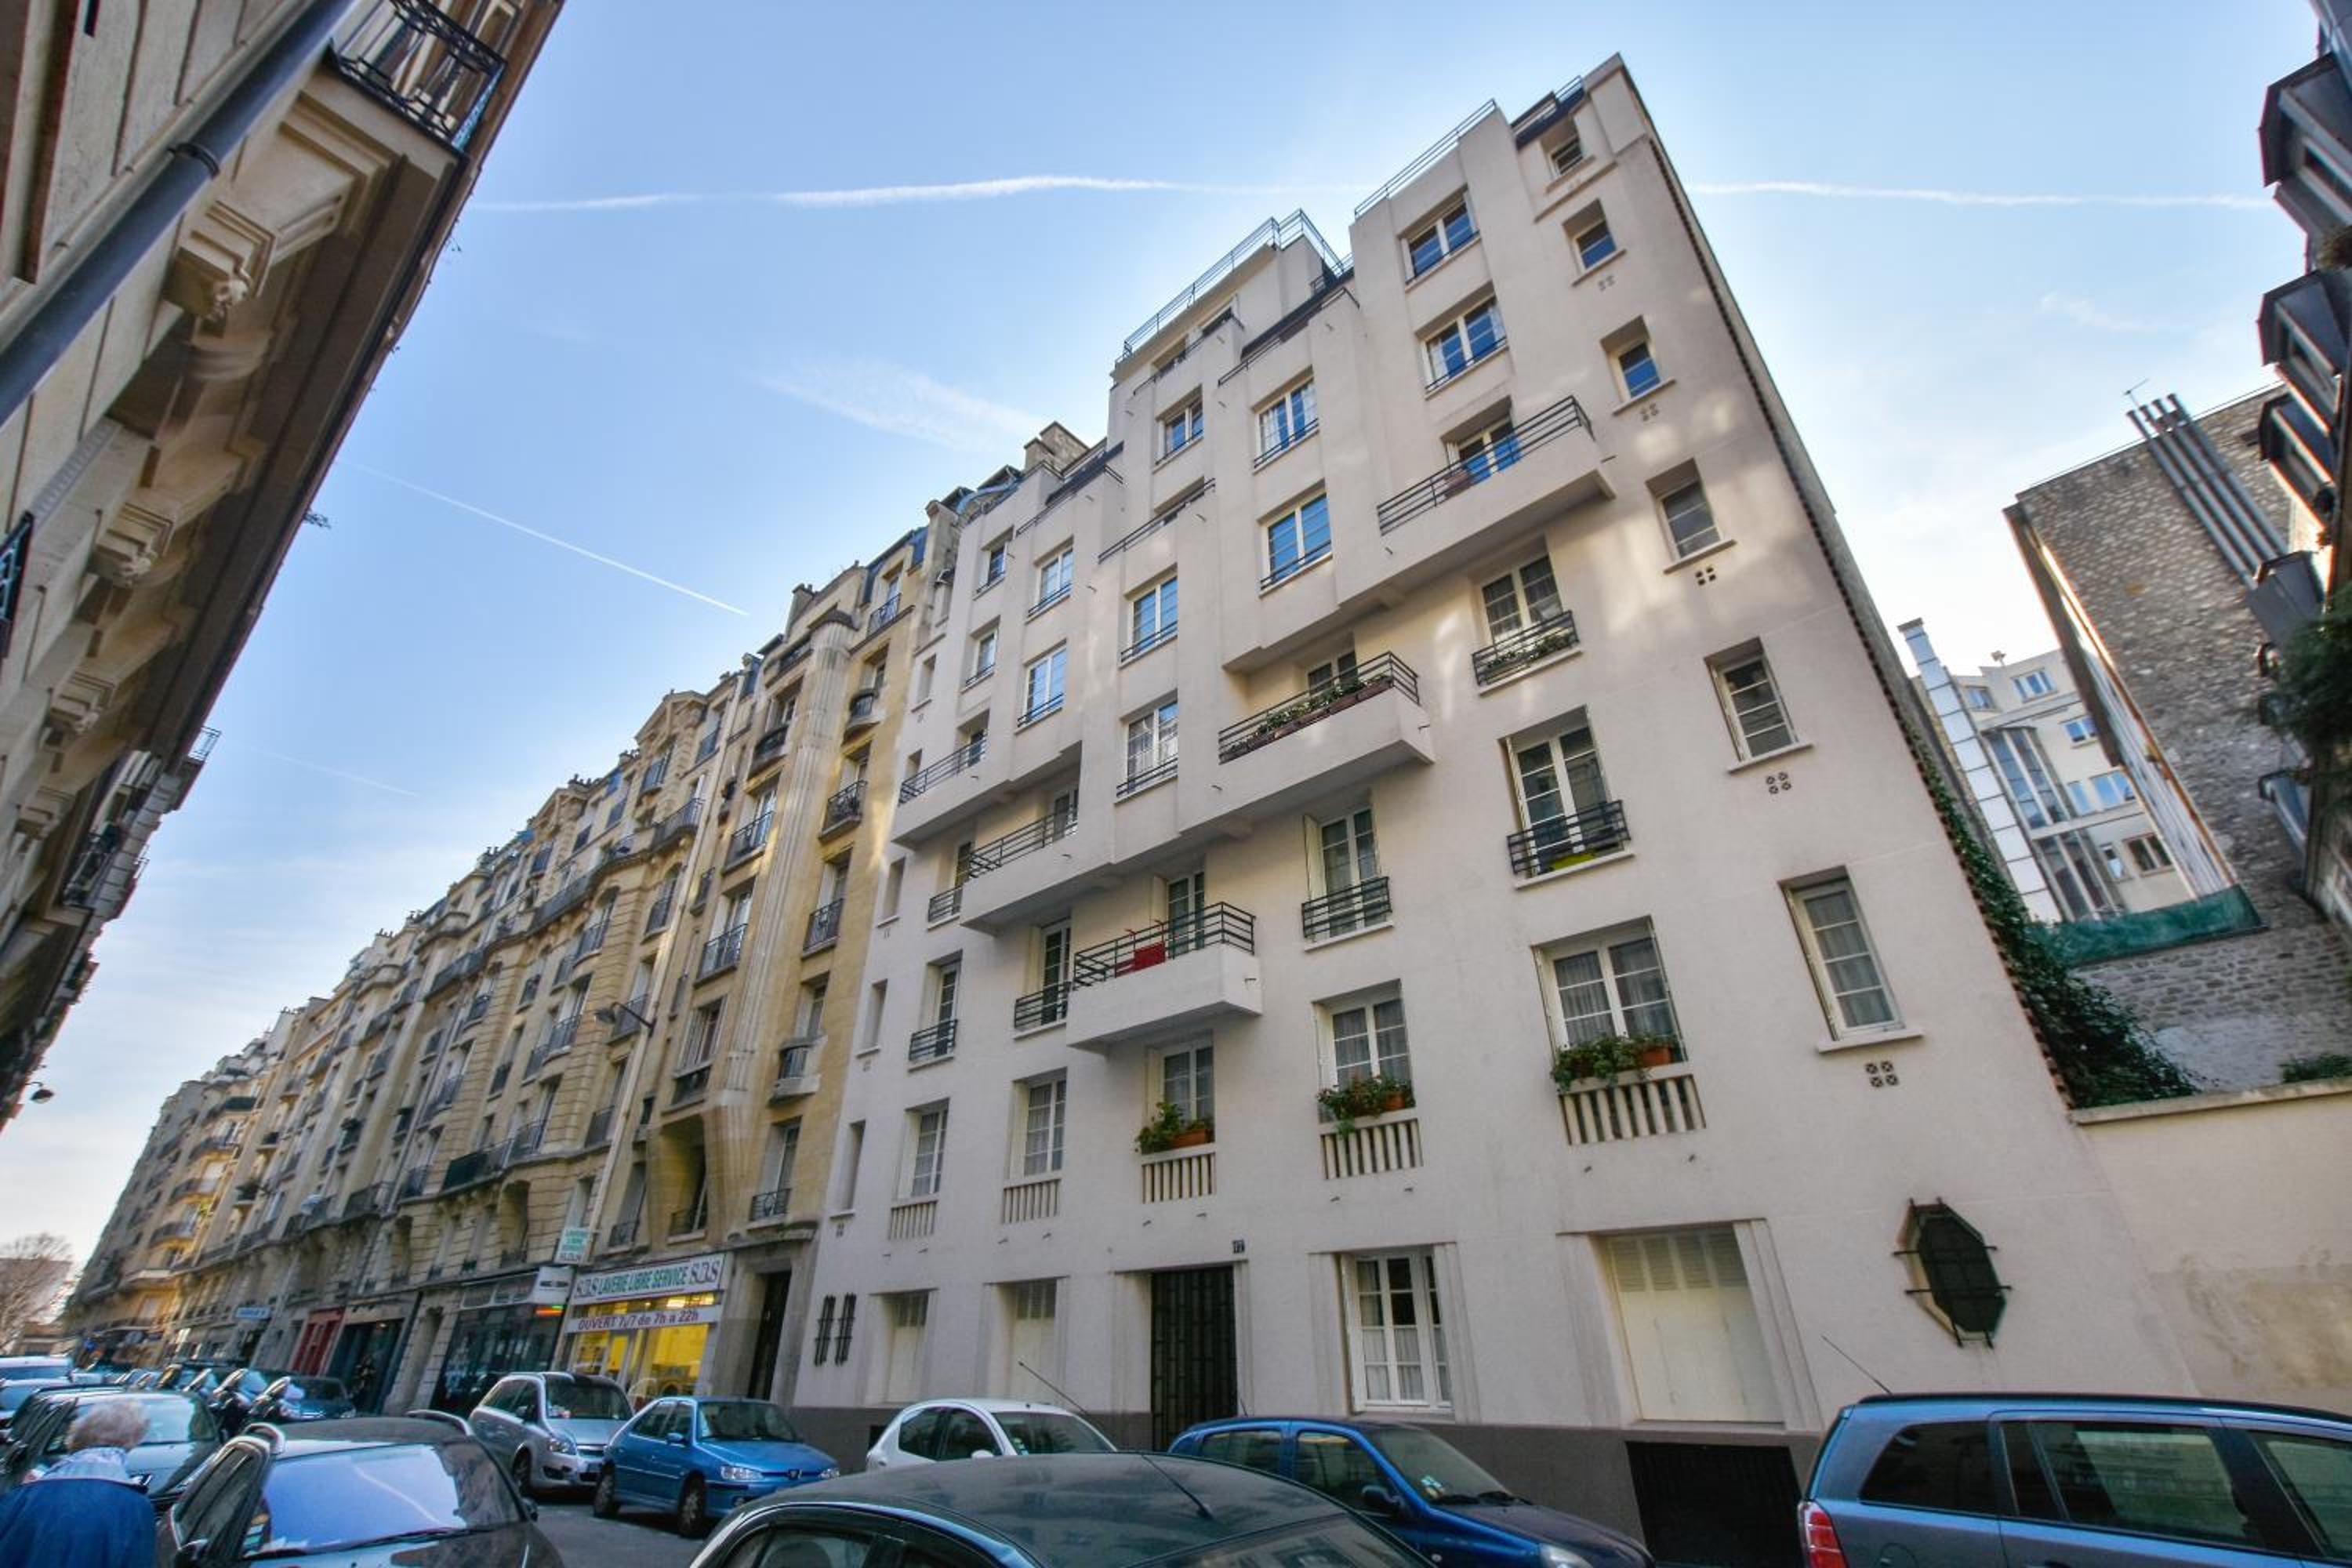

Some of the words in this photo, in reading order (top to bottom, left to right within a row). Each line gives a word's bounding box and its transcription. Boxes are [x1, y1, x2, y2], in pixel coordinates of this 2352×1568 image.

[597, 1273, 628, 1294] LAVERIE
[628, 1270, 652, 1291] LIBRE
[652, 1266, 688, 1287] SERVICE
[579, 1316, 618, 1330] OUVERT
[654, 1311, 666, 1323] 7h
[678, 1308, 699, 1323] 22h
